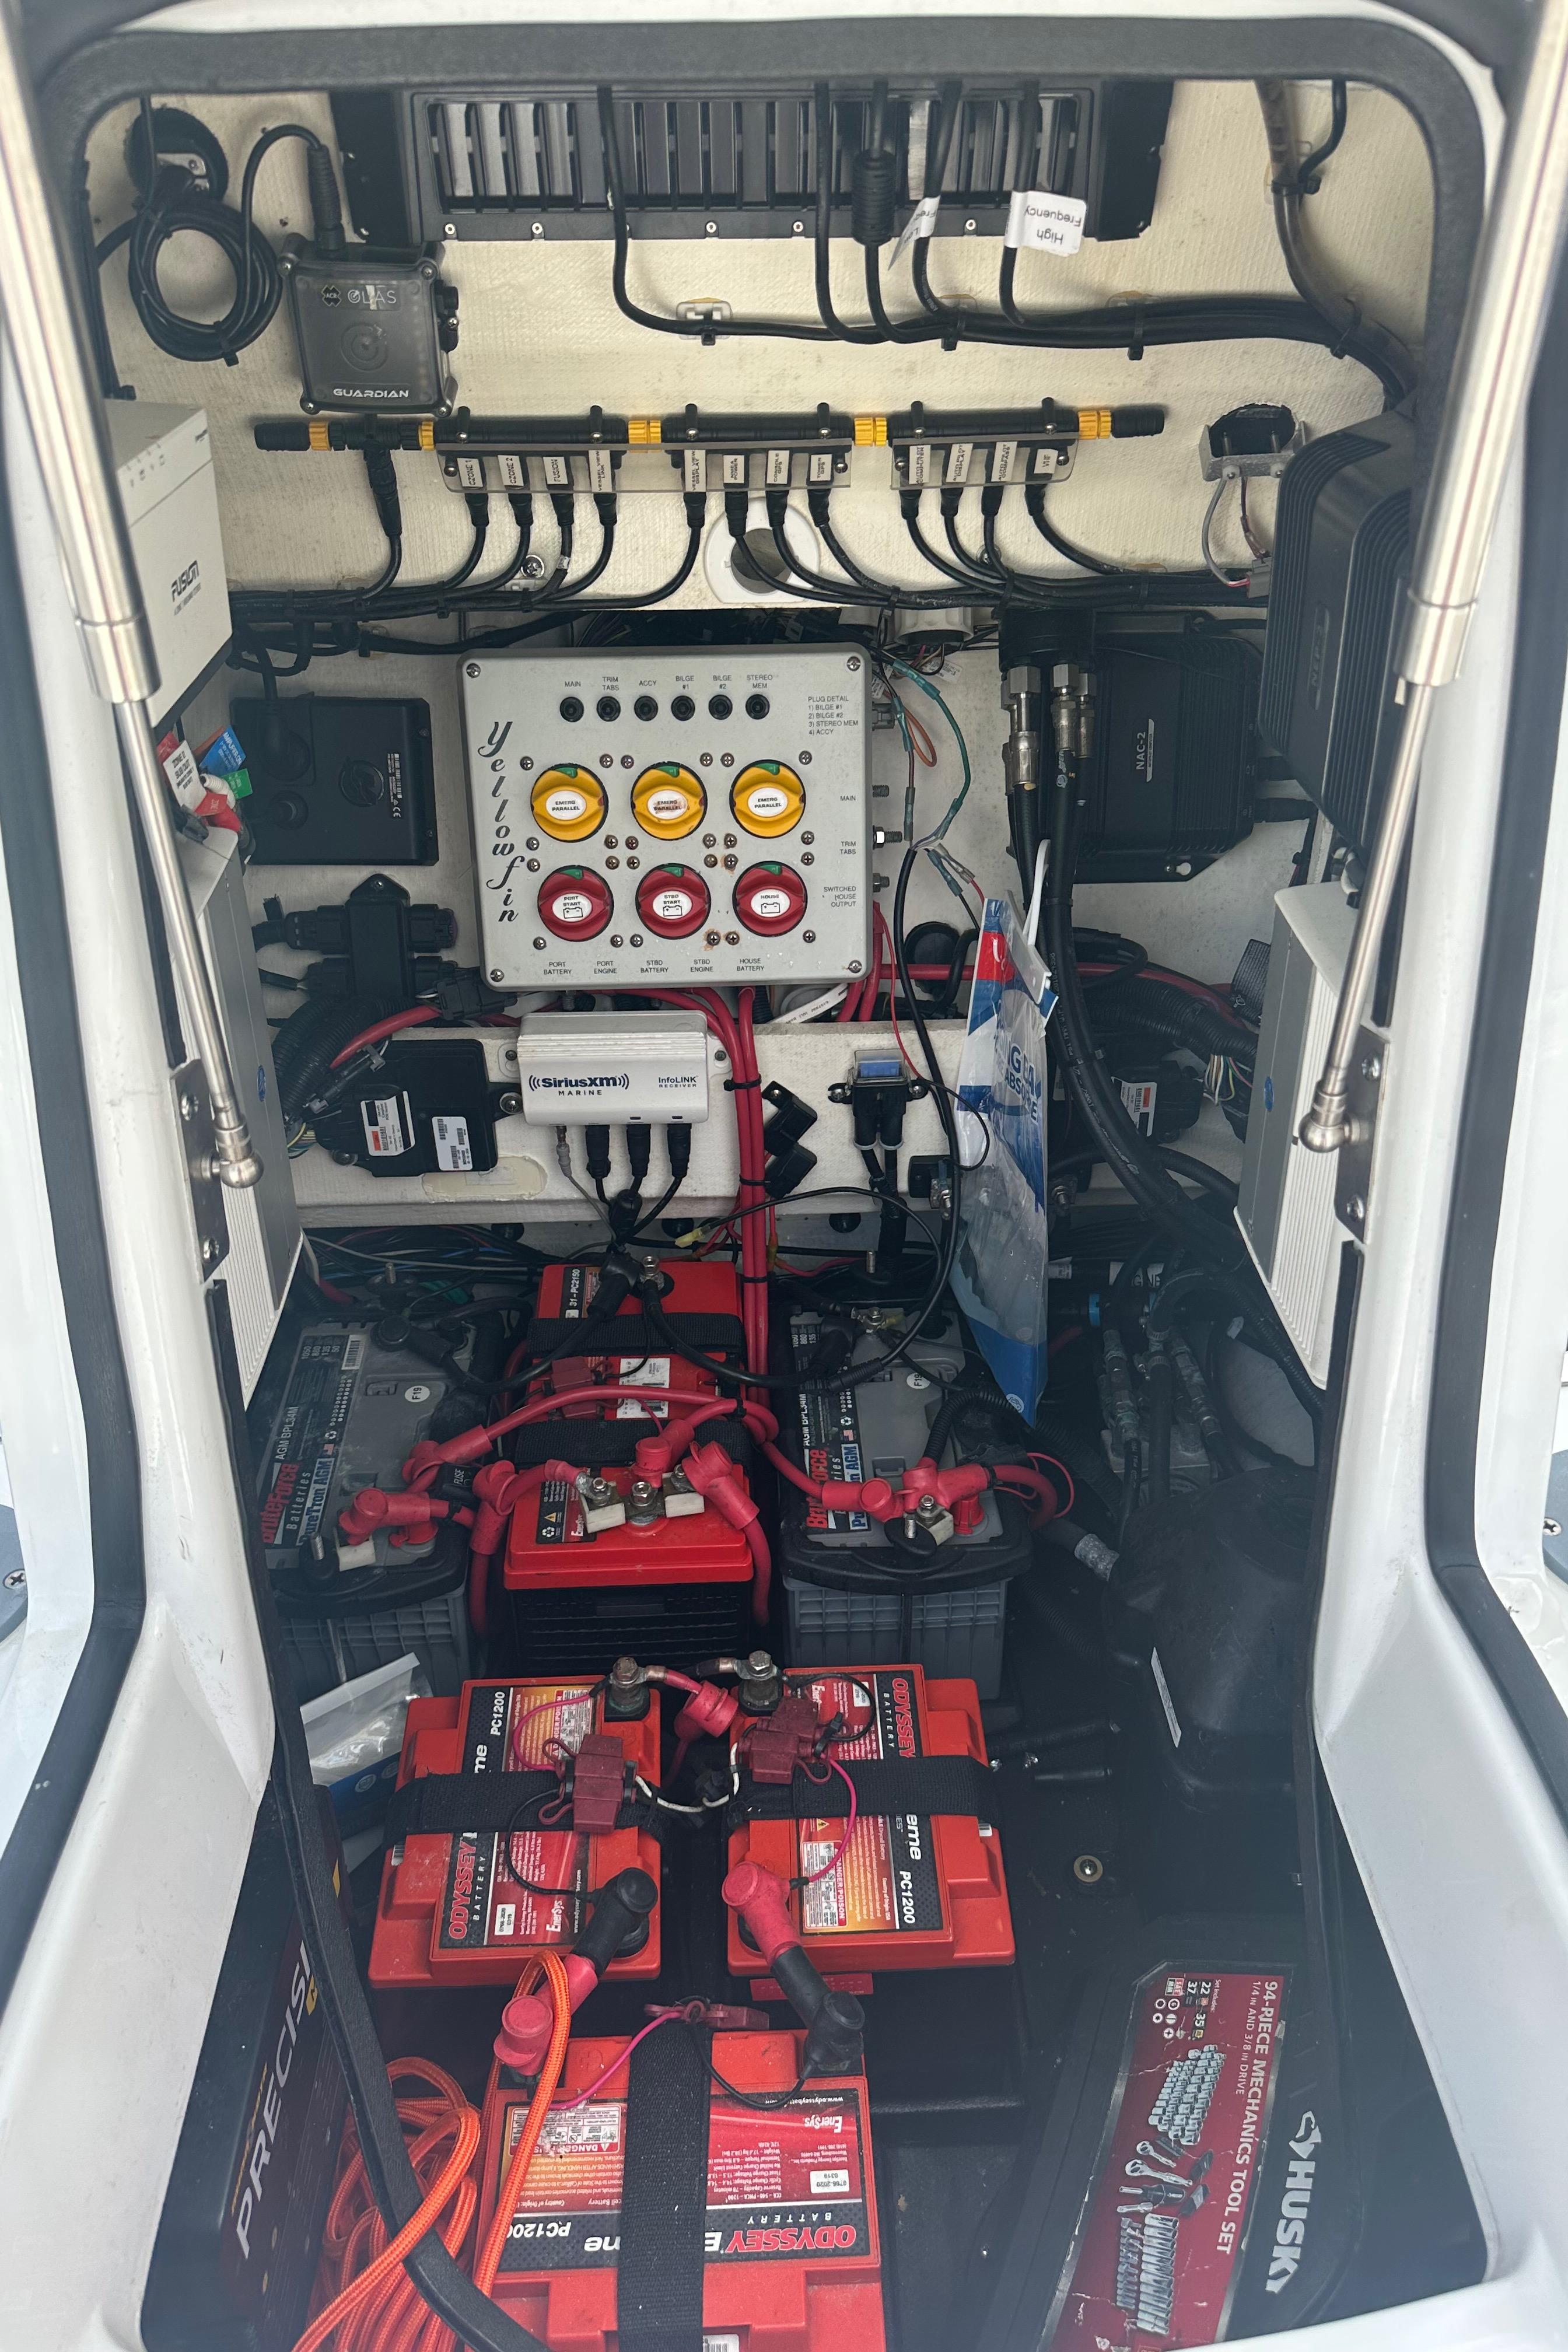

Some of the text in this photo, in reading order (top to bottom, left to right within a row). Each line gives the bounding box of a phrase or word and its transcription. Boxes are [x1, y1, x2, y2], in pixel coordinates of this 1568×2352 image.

[1025, 205, 1082, 227] Frequency
[1037, 229, 1063, 245] High
[333, 388, 409, 398] GUARDIAN
[551, 459, 561, 482] FUSION
[171, 559, 200, 603] FUSION
[1136, 732, 1146, 769] NAC-2
[412, 1387, 421, 1401] F19
[275, 1440, 289, 1460] AGM
[843, 1446, 858, 1471] AGM
[454, 1468, 464, 1485] FUSE
[286, 1472, 312, 1530] Batteries
[489, 1690, 506, 1736] PC1200
[883, 1692, 895, 1748] BATTERY
[891, 1677, 917, 1758] ODYSSEY
[448, 1841, 476, 1939] ODYSSEY
[473, 1856, 486, 1921] BATTERY
[898, 1869, 917, 1924] PC1200
[546, 1900, 565, 1932] EnerSys
[1187, 1981, 1198, 1994] 37
[1200, 1982, 1212, 1994] 22
[1195, 2013, 1206, 2027] 35
[1236, 1980, 1261, 2095] 1/4 IN AND 3/8 IN DRIVE
[236, 1939, 313, 2260] PRECISI
[1235, 2059, 1274, 2165] MECHANICS
[804, 2113, 844, 2134] EnerSys
[588, 2197, 610, 2206] Battery
[1223, 2168, 1248, 2217] TOOL
[746, 2212, 832, 2224] BATTERY
[724, 2225, 857, 2253] ODYSSEY
[1216, 2221, 1236, 2255] SET
